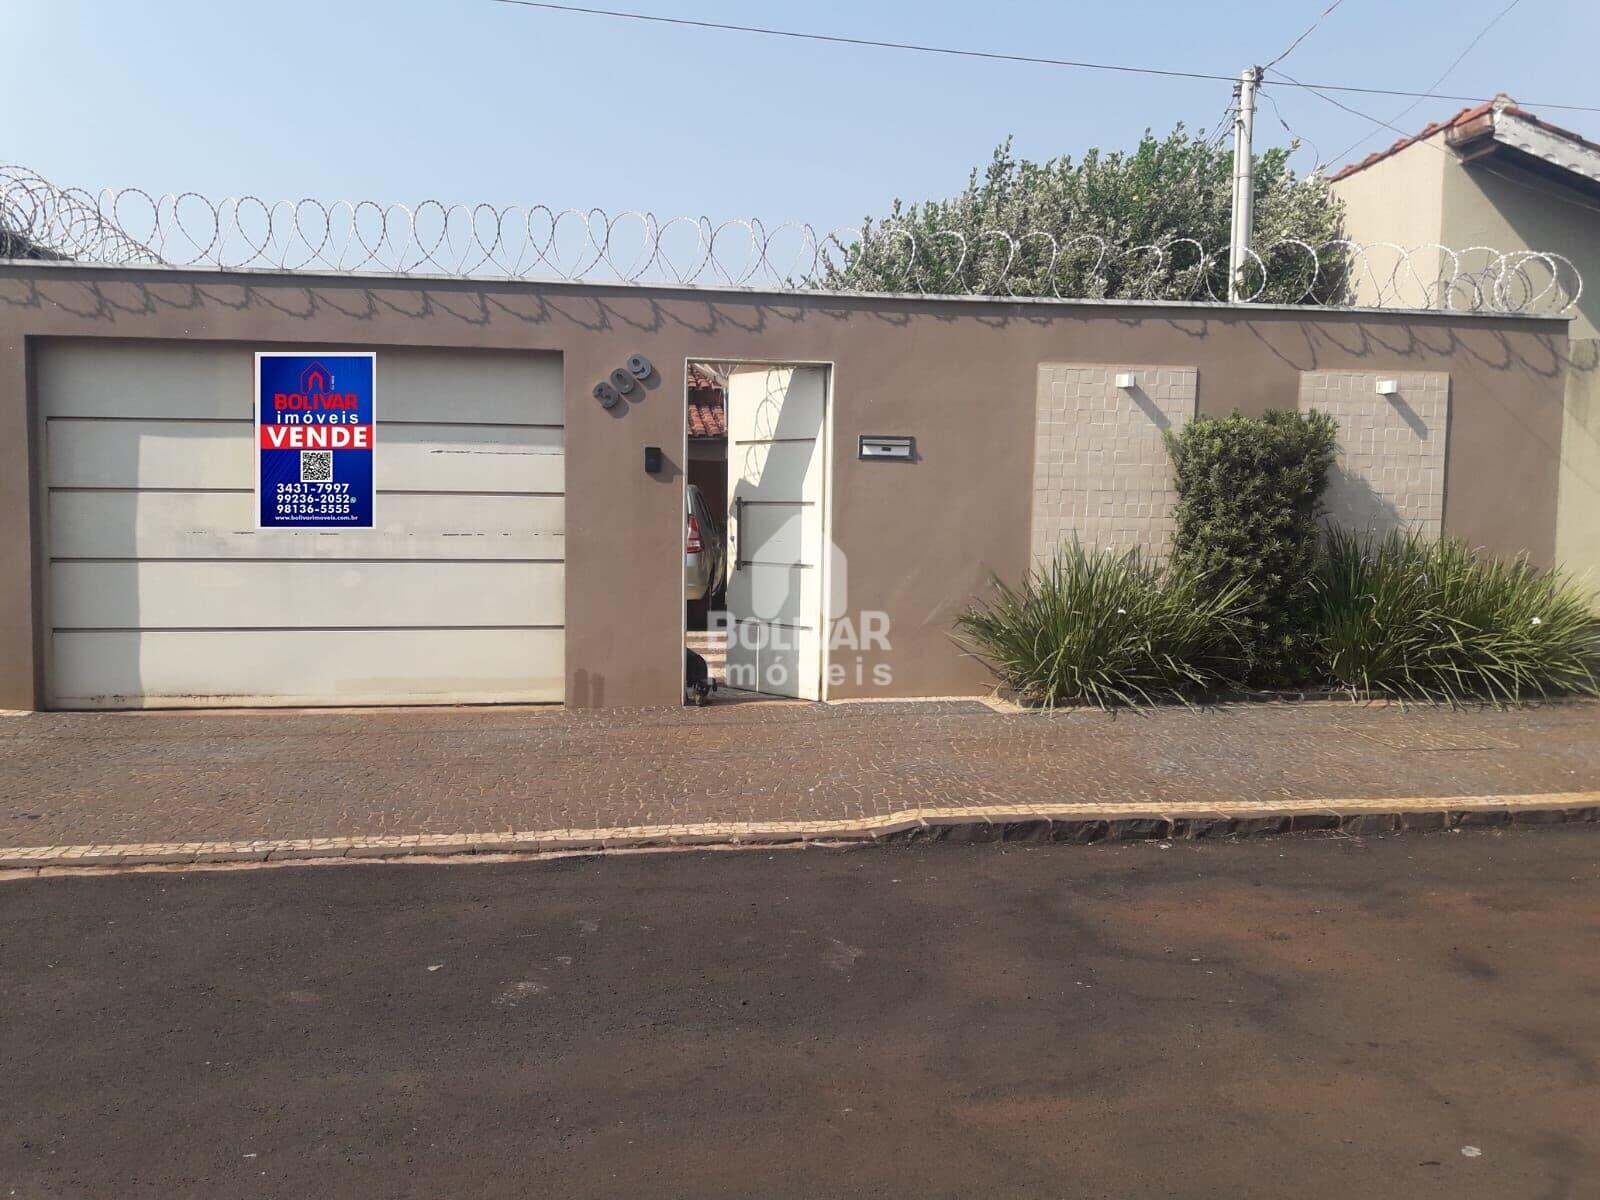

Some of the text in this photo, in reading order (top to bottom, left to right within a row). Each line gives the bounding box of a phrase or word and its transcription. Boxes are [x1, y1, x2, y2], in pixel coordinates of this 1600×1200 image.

[592, 353, 651, 409] 309
[274, 393, 357, 410] BOLIVAR
[277, 411, 359, 424] imóveis
[267, 426, 367, 448] VENDE
[276, 483, 350, 494] 3431-7997
[276, 494, 350, 504] 99236-2052
[276, 504, 350, 514] 98136-5555
